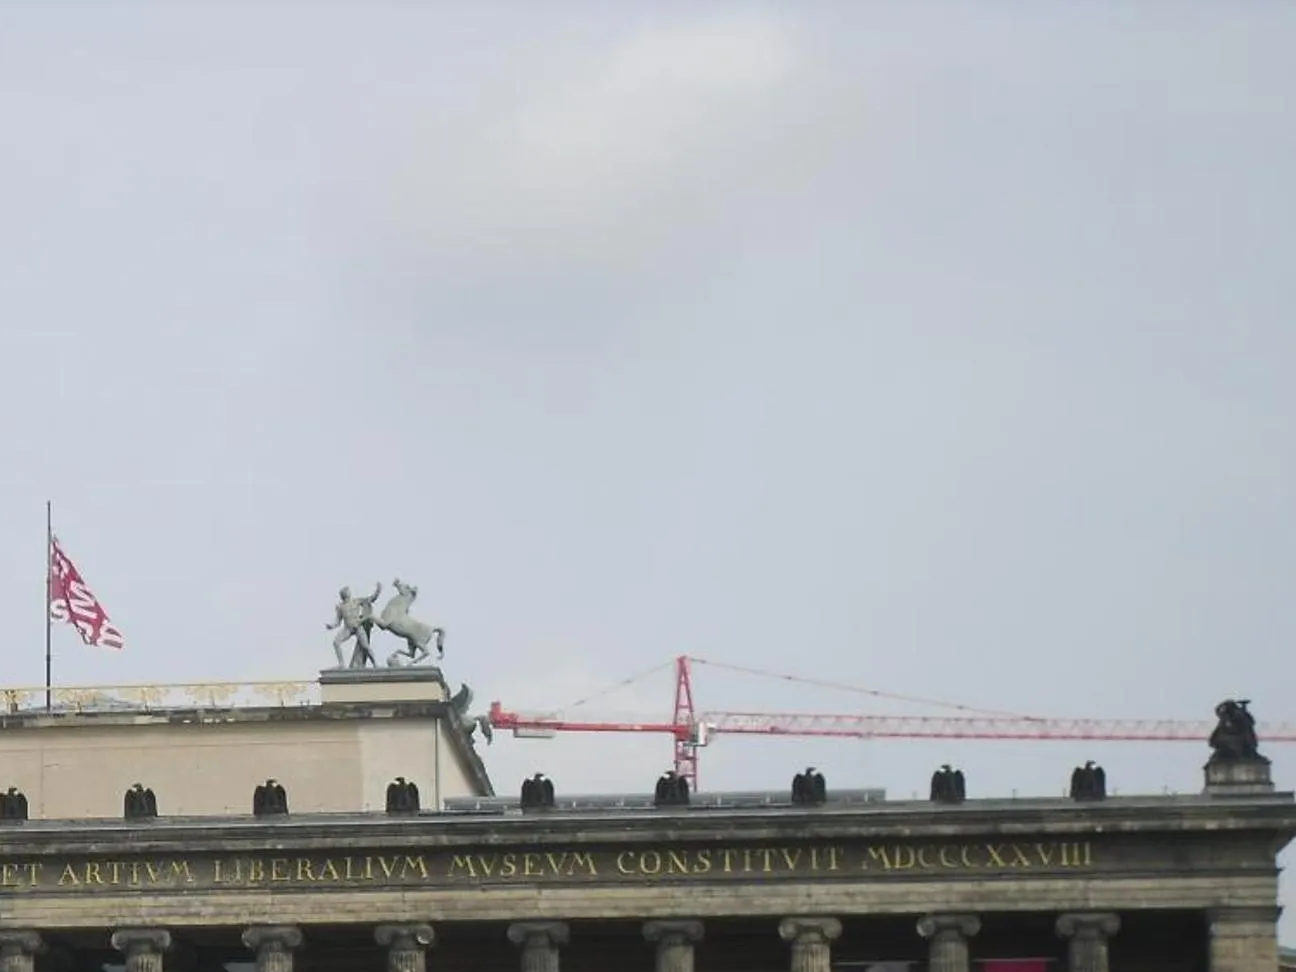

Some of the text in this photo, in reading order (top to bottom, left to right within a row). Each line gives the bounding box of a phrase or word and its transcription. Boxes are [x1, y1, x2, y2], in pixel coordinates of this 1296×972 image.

[1, 863, 43, 886] ET
[57, 860, 194, 885] ARTIVM
[213, 856, 428, 882] LIBERALIVM
[447, 851, 598, 877] MVSEVM
[616, 848, 843, 874] CONSTITVIT
[862, 843, 1091, 869] MDCCCXXVIII
